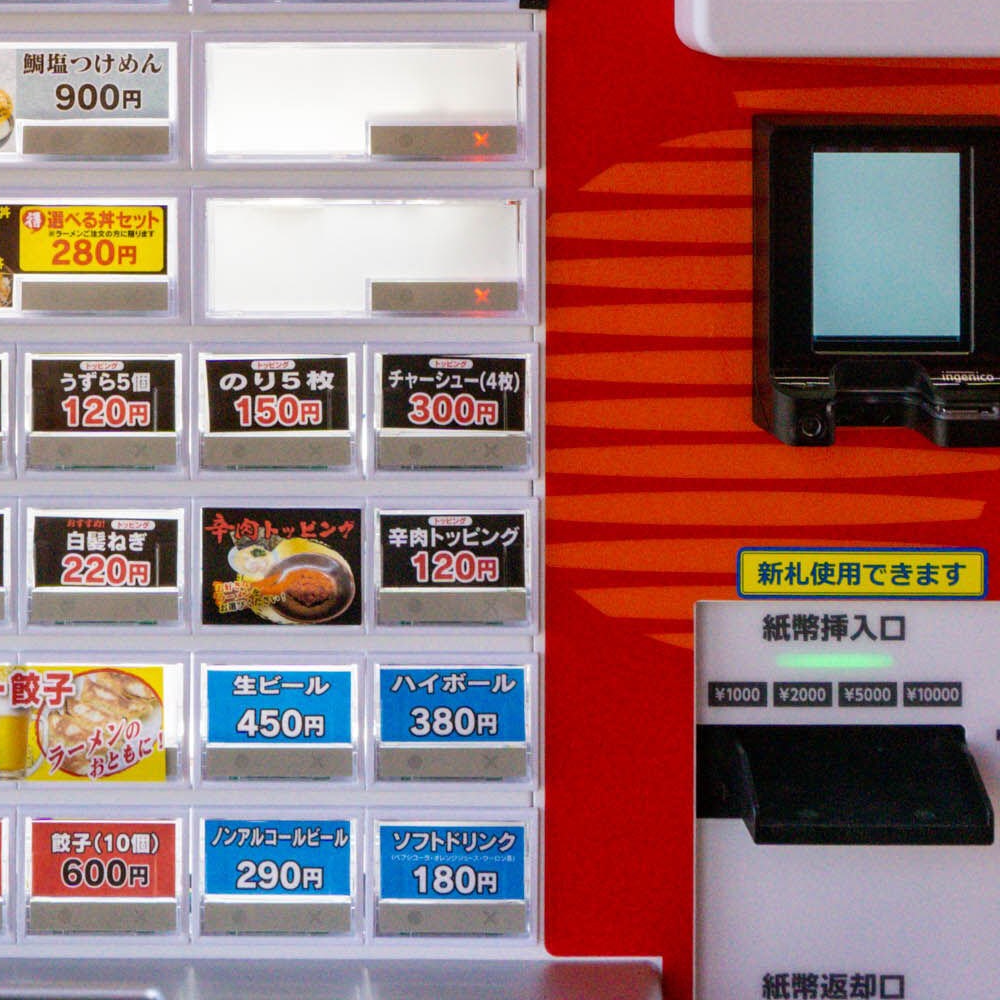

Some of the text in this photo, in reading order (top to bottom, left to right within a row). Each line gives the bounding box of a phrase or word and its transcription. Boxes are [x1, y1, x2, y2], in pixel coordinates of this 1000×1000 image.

[23, 53, 162, 75] 鯛塩つけめん
[55, 83, 142, 111] 900円
[48, 210, 161, 230] 選べる丼セット
[51, 239, 138, 267] 280円
[60, 372, 151, 392] うずら5個
[219, 371, 335, 391] のり5枚
[388, 370, 520, 392] チャーシュー(4枚)
[941, 371, 994, 383] ingenico
[61, 395, 151, 428] 120円
[233, 393, 322, 427] 150円
[408, 392, 499, 426] 300円
[66, 532, 148, 551] 白髪ねぎ
[204, 513, 355, 543] 辛肉トッピング
[388, 527, 521, 547] 辛肉トッピング
[61, 553, 151, 586] 220円
[411, 550, 500, 583] 120円
[757, 561, 967, 587] 新札使用できます
[762, 614, 906, 642] 紙幣挿入口
[232, 675, 331, 697] 生ビール
[391, 673, 518, 695] ハイボール
[714, 687, 960, 703] ¥1000 ¥2000 ¥5000 ¥10000
[235, 708, 326, 738] 450円
[409, 706, 499, 737] 380円
[48, 719, 141, 775] ラーメンの
[50, 833, 160, 854] 餃子(10個)
[210, 827, 350, 848] ノンアルコールビール
[393, 831, 517, 852] ソフトドリンク
[61, 857, 150, 888] 600円
[235, 859, 324, 890] 290円
[412, 864, 499, 895] 180円
[761, 973, 906, 1000] 紙幣返却口
